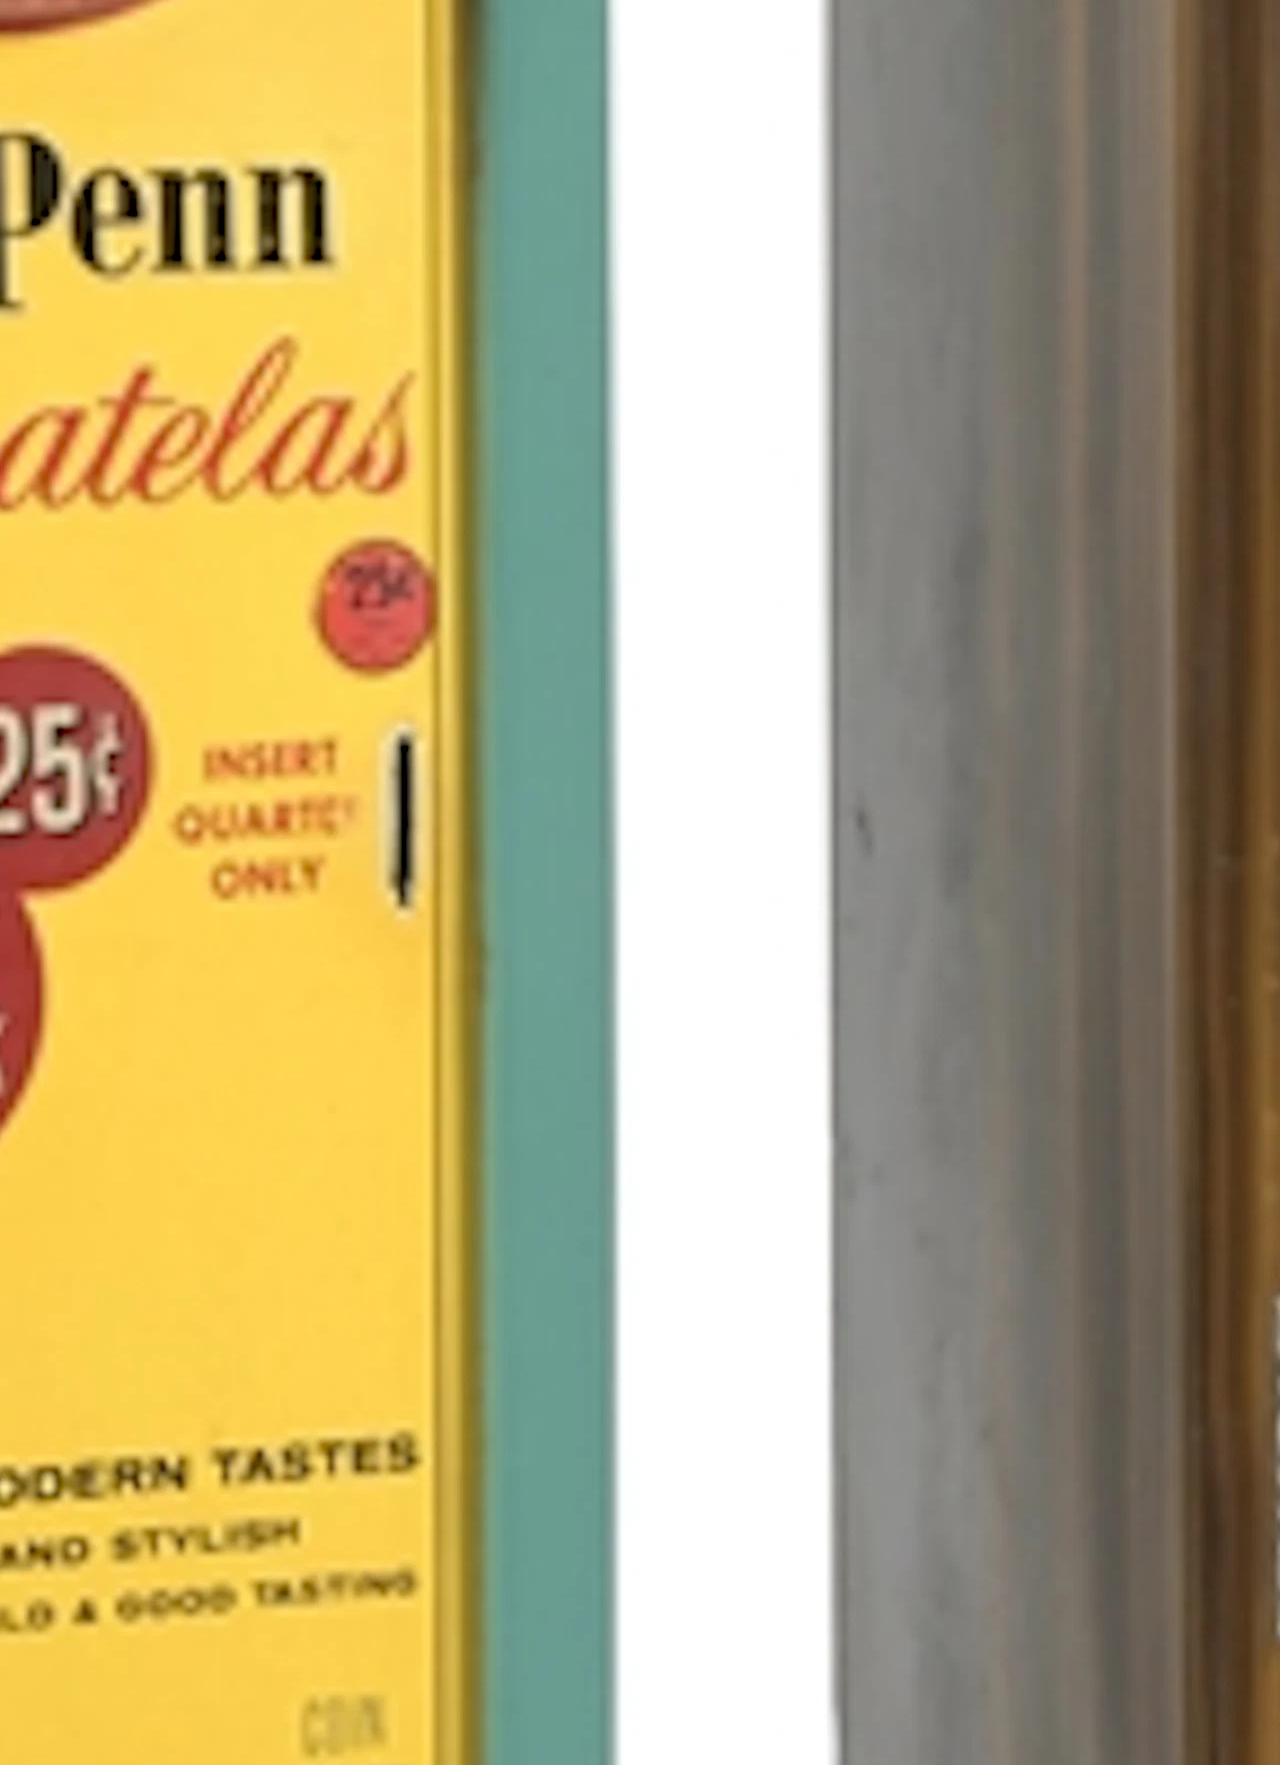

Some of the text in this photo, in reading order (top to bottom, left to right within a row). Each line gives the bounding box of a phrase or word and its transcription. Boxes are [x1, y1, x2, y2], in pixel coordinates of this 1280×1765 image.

[201, 739, 340, 780] INSERT
[211, 858, 326, 900] ONLY
[213, 1431, 421, 1487] TASTES
[112, 1515, 302, 1561] STYLISH
[116, 1584, 237, 1620] GOOD
[253, 1566, 419, 1608] TASTING
[302, 1695, 384, 1756] COIN
